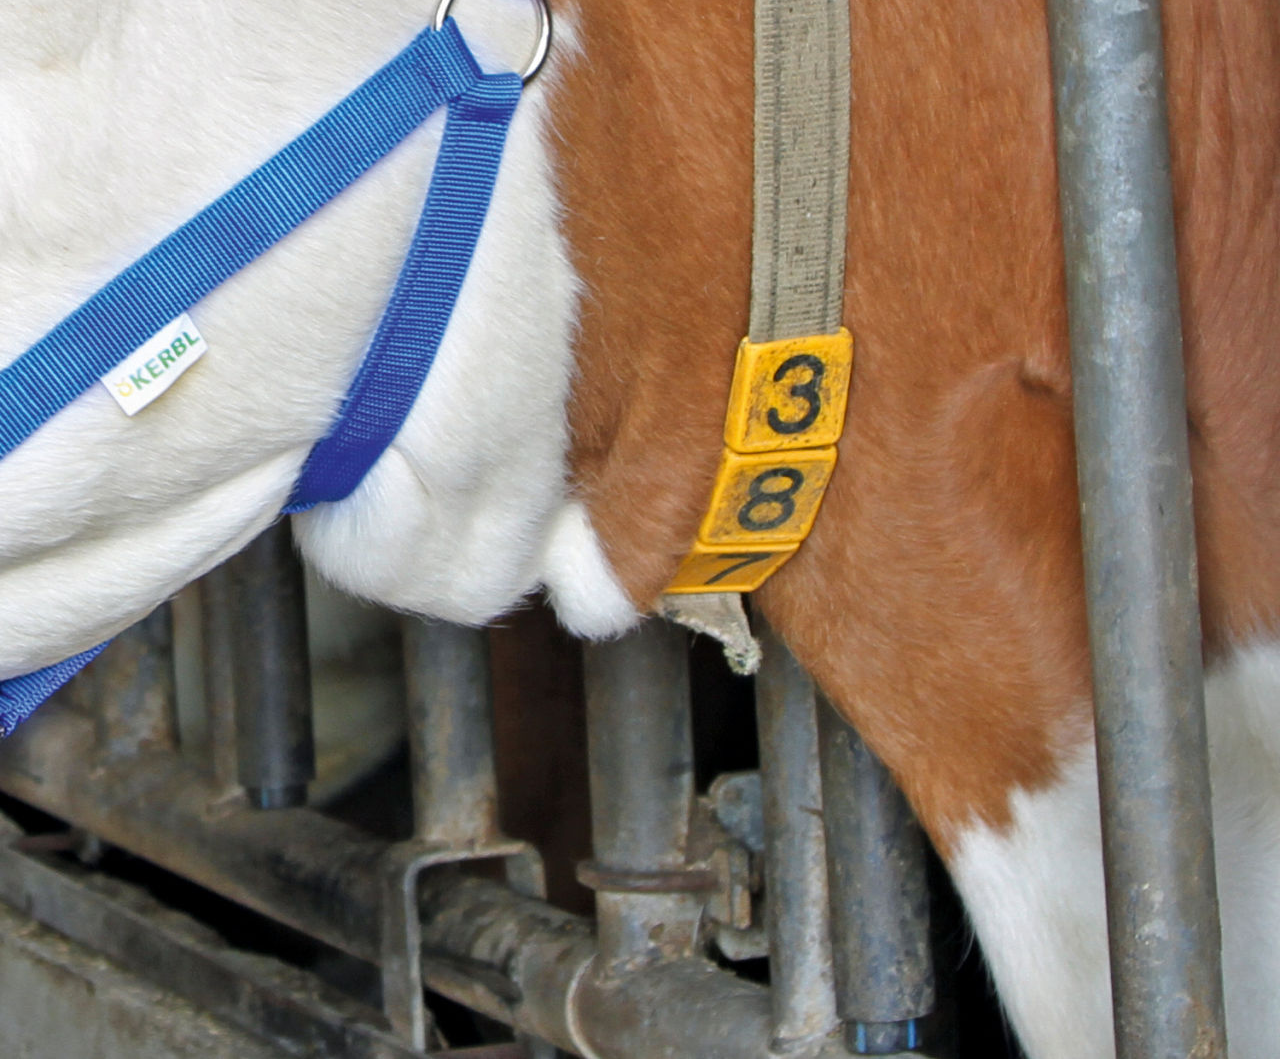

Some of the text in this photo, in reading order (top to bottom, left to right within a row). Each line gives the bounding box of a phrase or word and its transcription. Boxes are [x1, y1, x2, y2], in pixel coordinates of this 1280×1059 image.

[129, 331, 200, 390] KERBL
[768, 354, 825, 435] 3
[738, 468, 804, 531] 8
